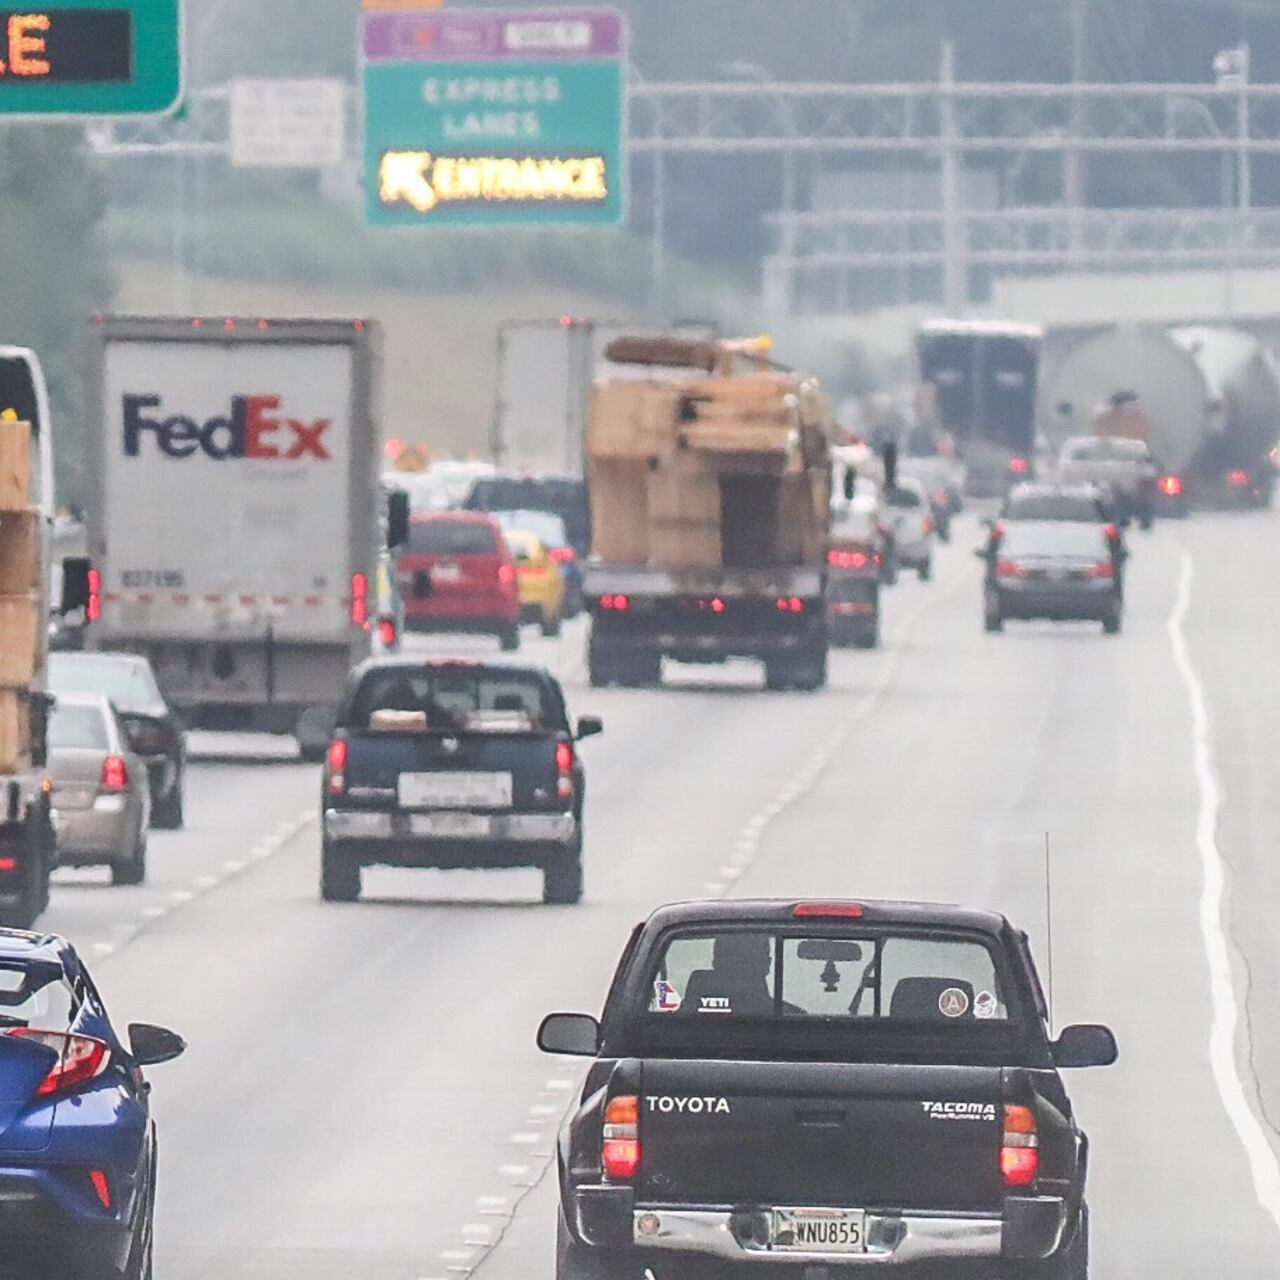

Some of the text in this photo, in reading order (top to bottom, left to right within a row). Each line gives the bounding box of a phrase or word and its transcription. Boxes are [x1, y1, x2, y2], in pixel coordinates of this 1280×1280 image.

[423, 76, 560, 103] EXPRESS
[442, 112, 540, 138] LANES
[433, 156, 607, 190] ENTRANCE
[121, 393, 329, 462] FedEx
[700, 997, 730, 1008] YETI
[645, 1095, 731, 1114] TOYOTA
[921, 1101, 996, 1114] TACOMA
